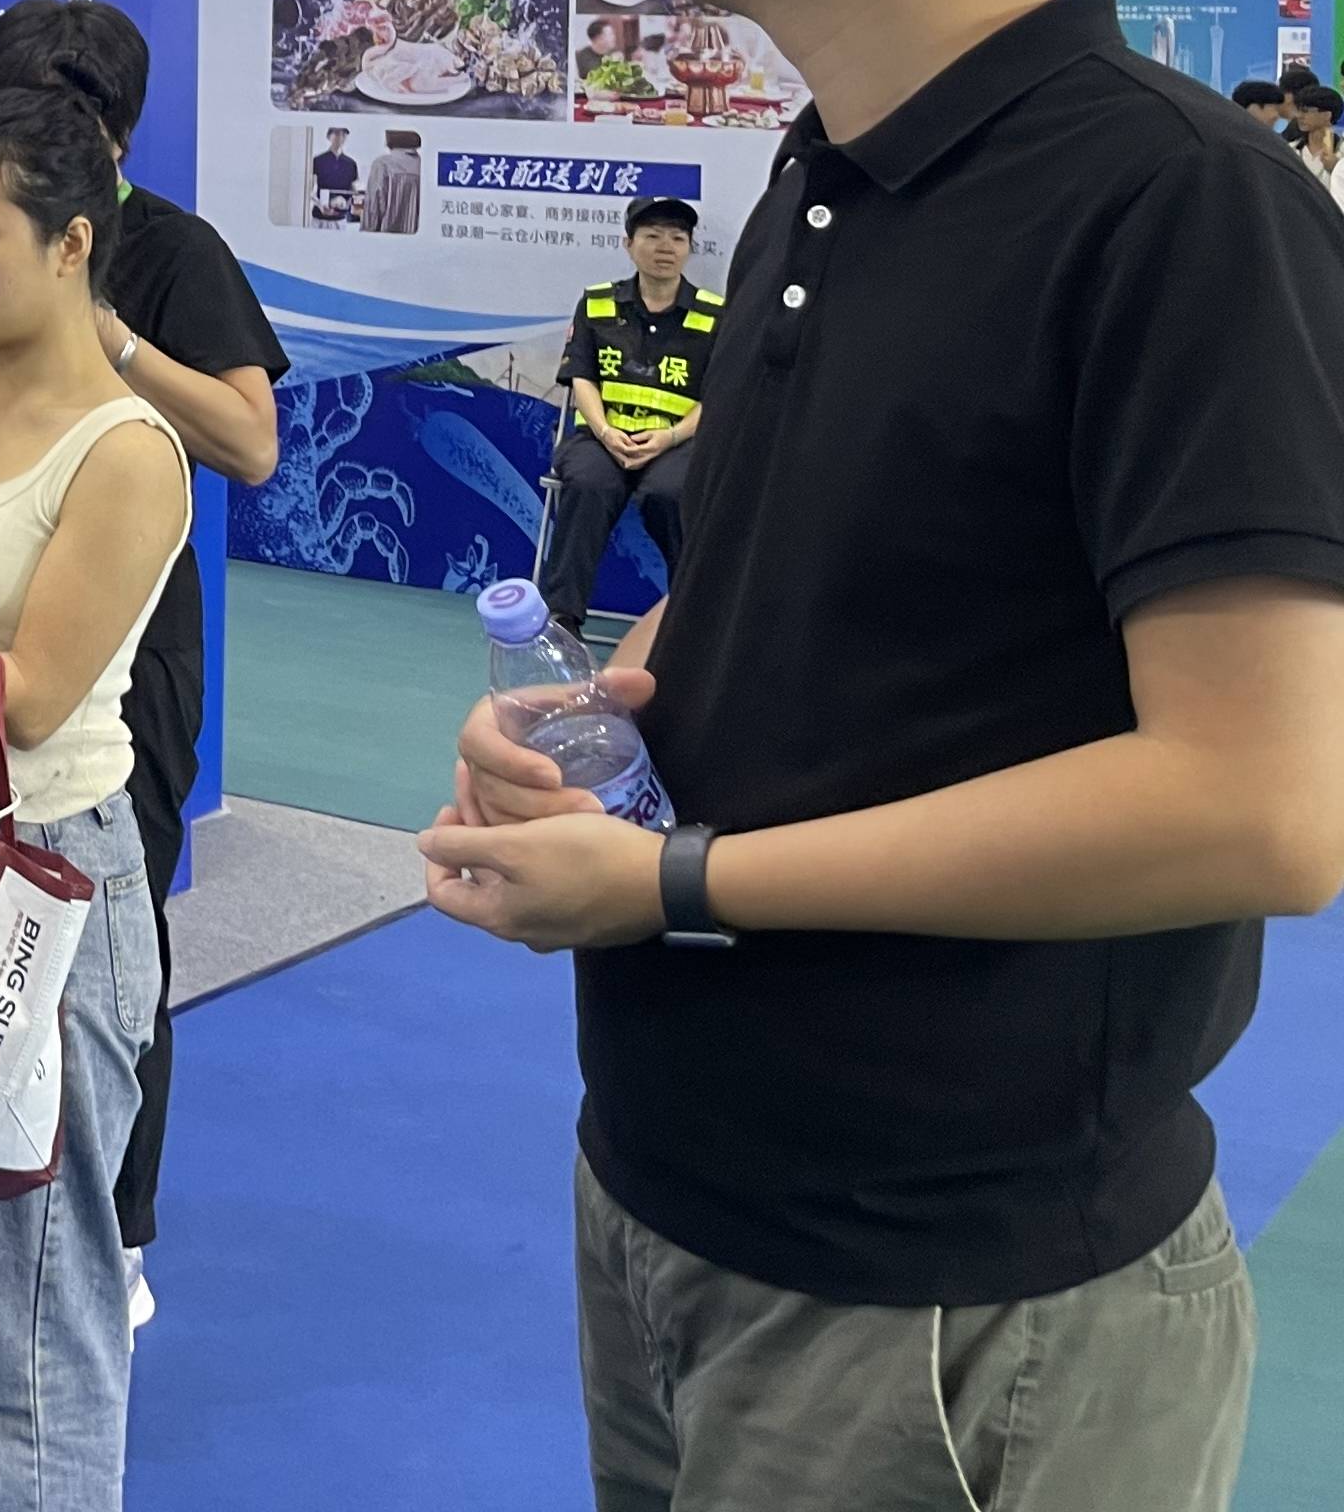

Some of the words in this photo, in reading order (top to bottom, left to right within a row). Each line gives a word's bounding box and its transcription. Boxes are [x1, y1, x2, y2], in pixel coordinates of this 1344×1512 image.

[447, 154, 644, 193] 高效配送到家
[6, 915, 41, 993] BING
